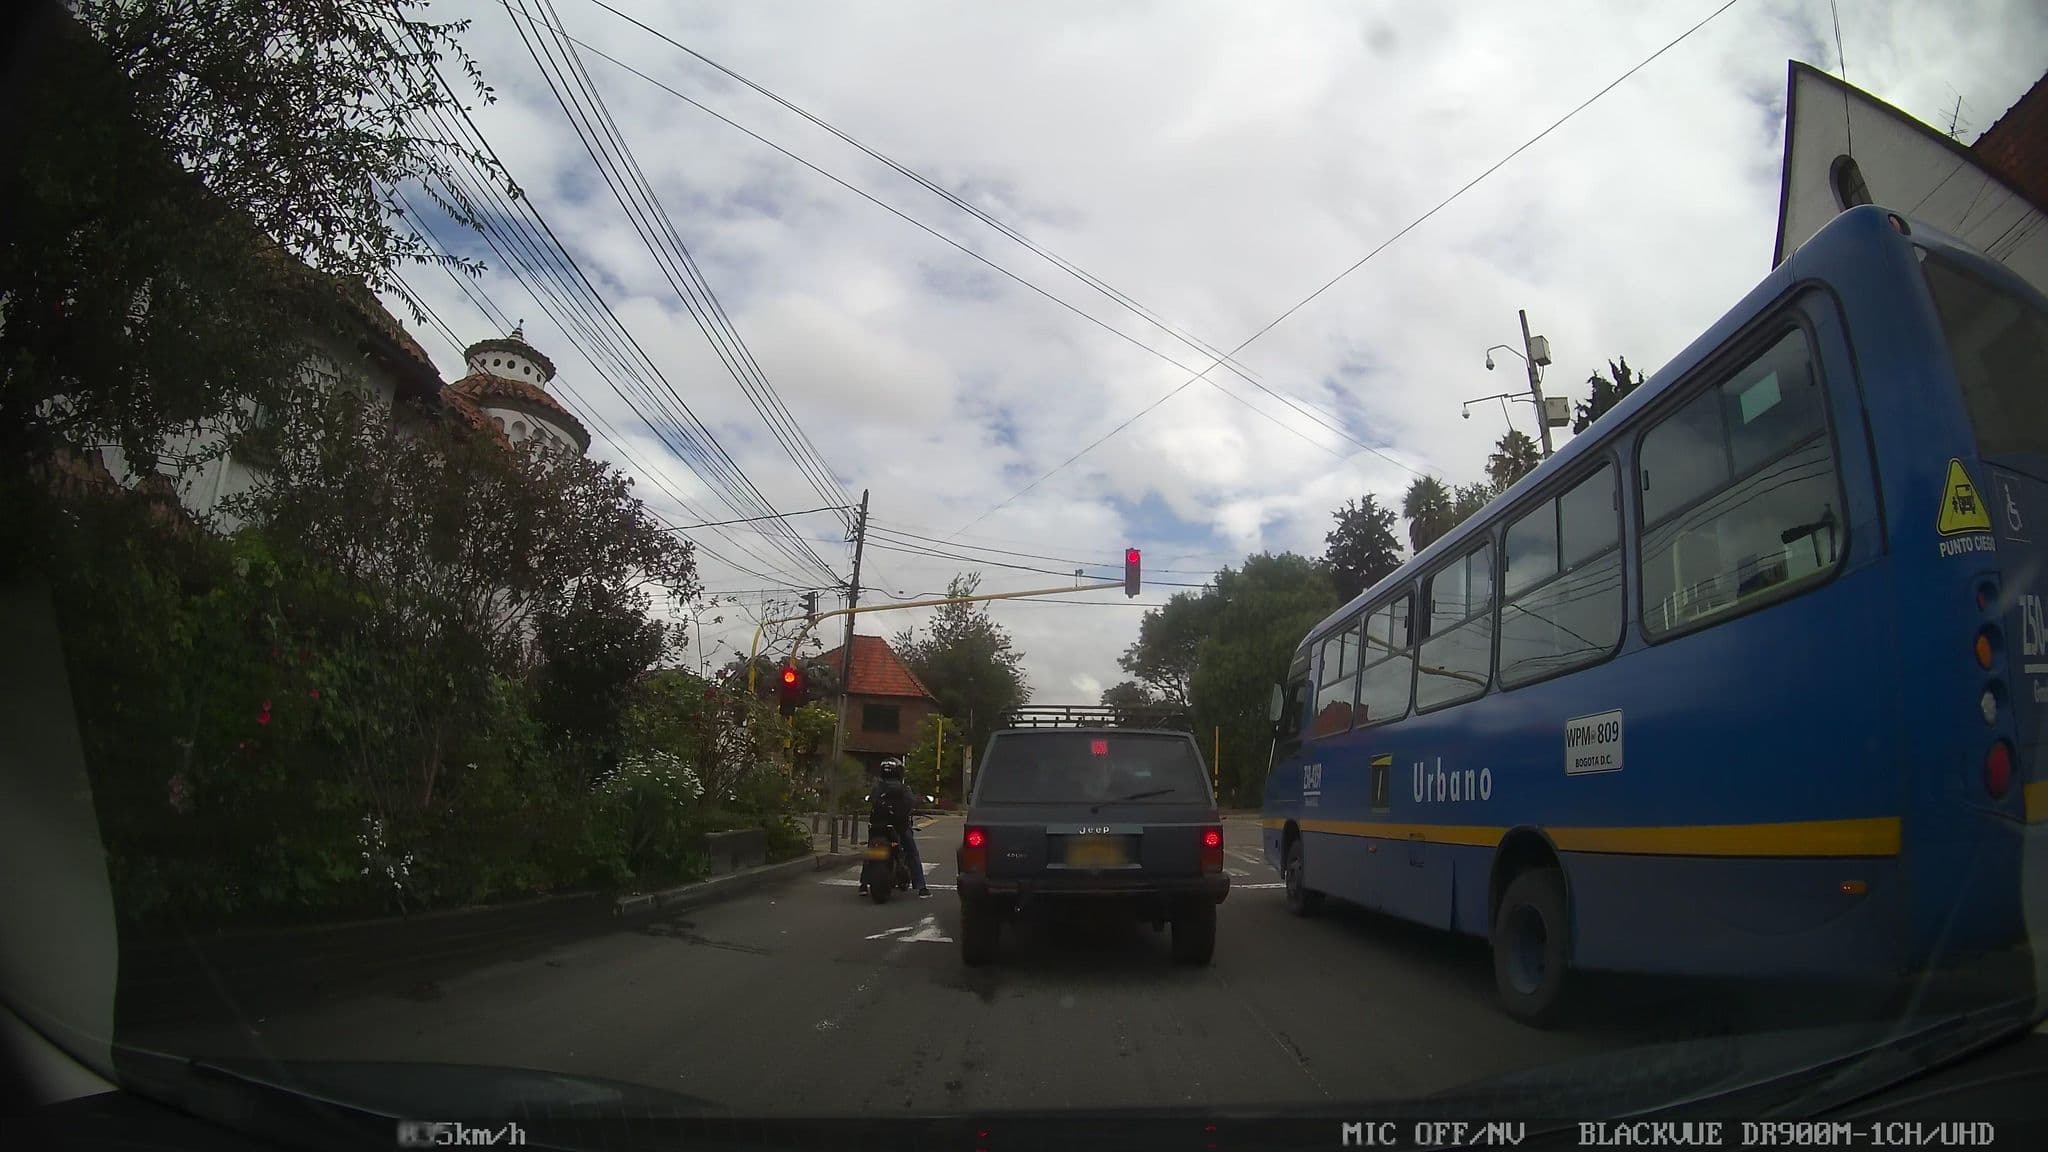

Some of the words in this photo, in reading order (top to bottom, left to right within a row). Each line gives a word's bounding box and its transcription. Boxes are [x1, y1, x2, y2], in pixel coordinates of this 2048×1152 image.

[1939, 536, 1974, 558] PUNTO
[1974, 535, 1996, 552] CIEGO
[1567, 726, 1591, 748] WPM
[1597, 721, 1619, 744] 809
[1413, 757, 1492, 803] Urbano
